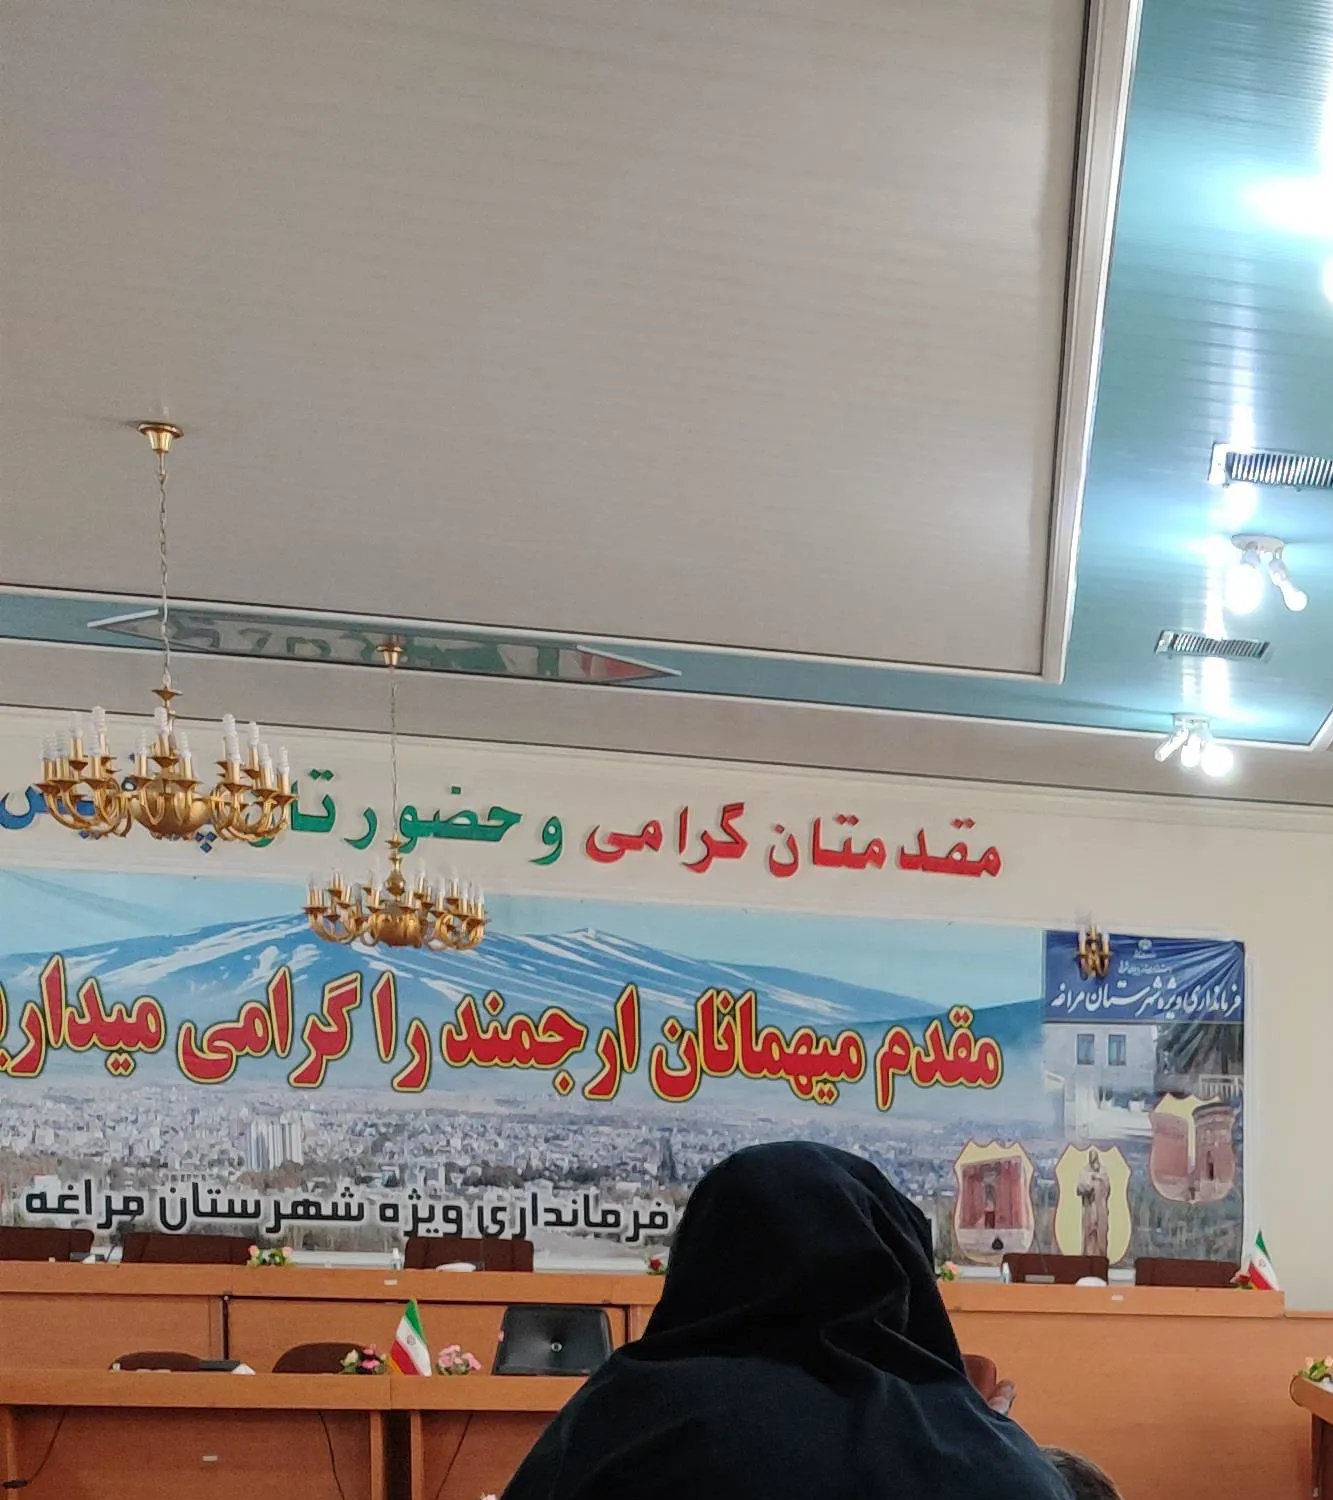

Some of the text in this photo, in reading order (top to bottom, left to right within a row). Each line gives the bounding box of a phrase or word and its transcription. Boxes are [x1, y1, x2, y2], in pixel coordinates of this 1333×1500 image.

[530, 814, 562, 865] و
[585, 801, 748, 872] گرامی
[768, 812, 1002, 878] مقدمتان
[0, 954, 1002, 1111] مقدم میهمانان ارجمند را گرامی میدار
[24, 1179, 671, 1243] فرمانداری ویژه شهرستان مراغه
